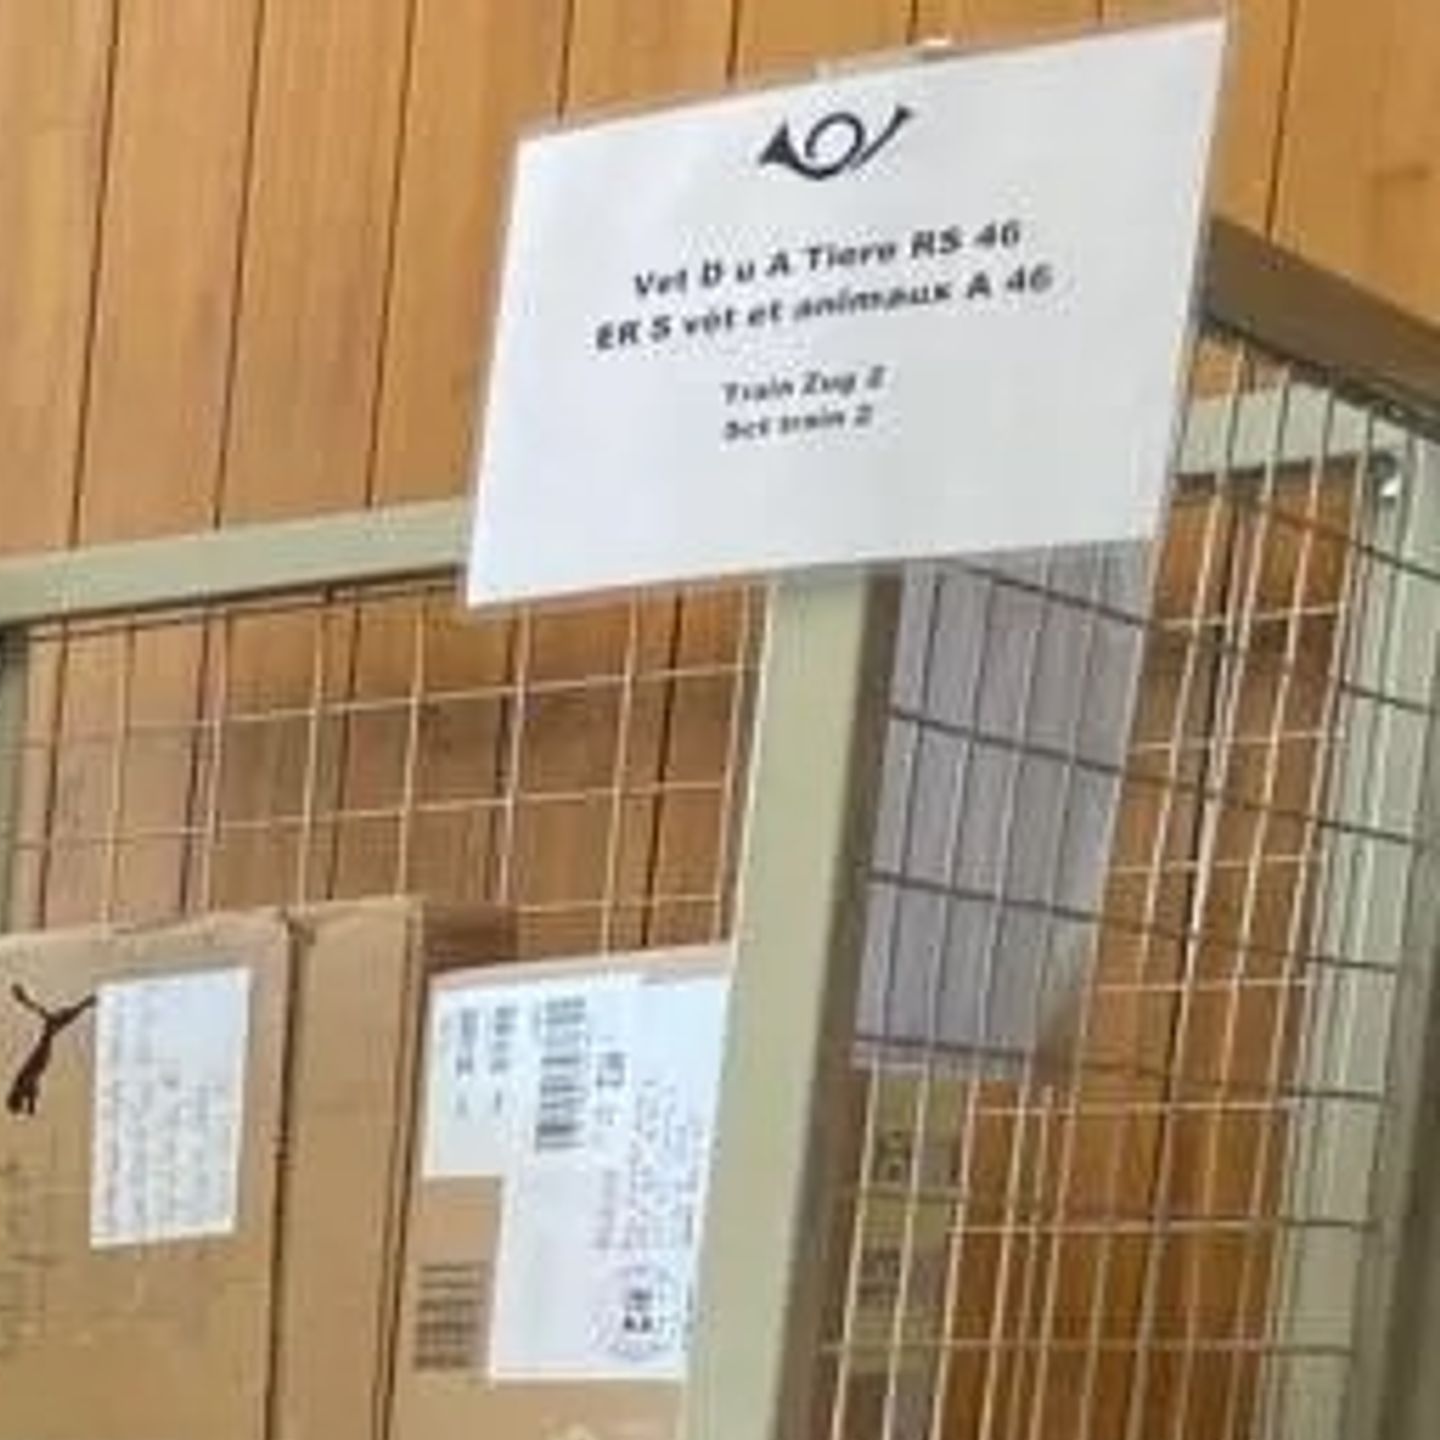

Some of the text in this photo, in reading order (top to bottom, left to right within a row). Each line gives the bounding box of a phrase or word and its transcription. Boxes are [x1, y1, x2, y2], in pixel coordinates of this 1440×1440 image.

[634, 271, 687, 298] Vet
[700, 259, 724, 289] D
[765, 252, 791, 278] A
[805, 241, 897, 273] Tiere
[910, 228, 963, 259] RS
[973, 220, 1022, 247] 46
[595, 319, 641, 351] ER
[650, 314, 673, 342] S
[747, 300, 782, 325] et
[792, 282, 951, 321] animaux
[966, 273, 992, 300] A
[1005, 264, 1055, 292] 46
